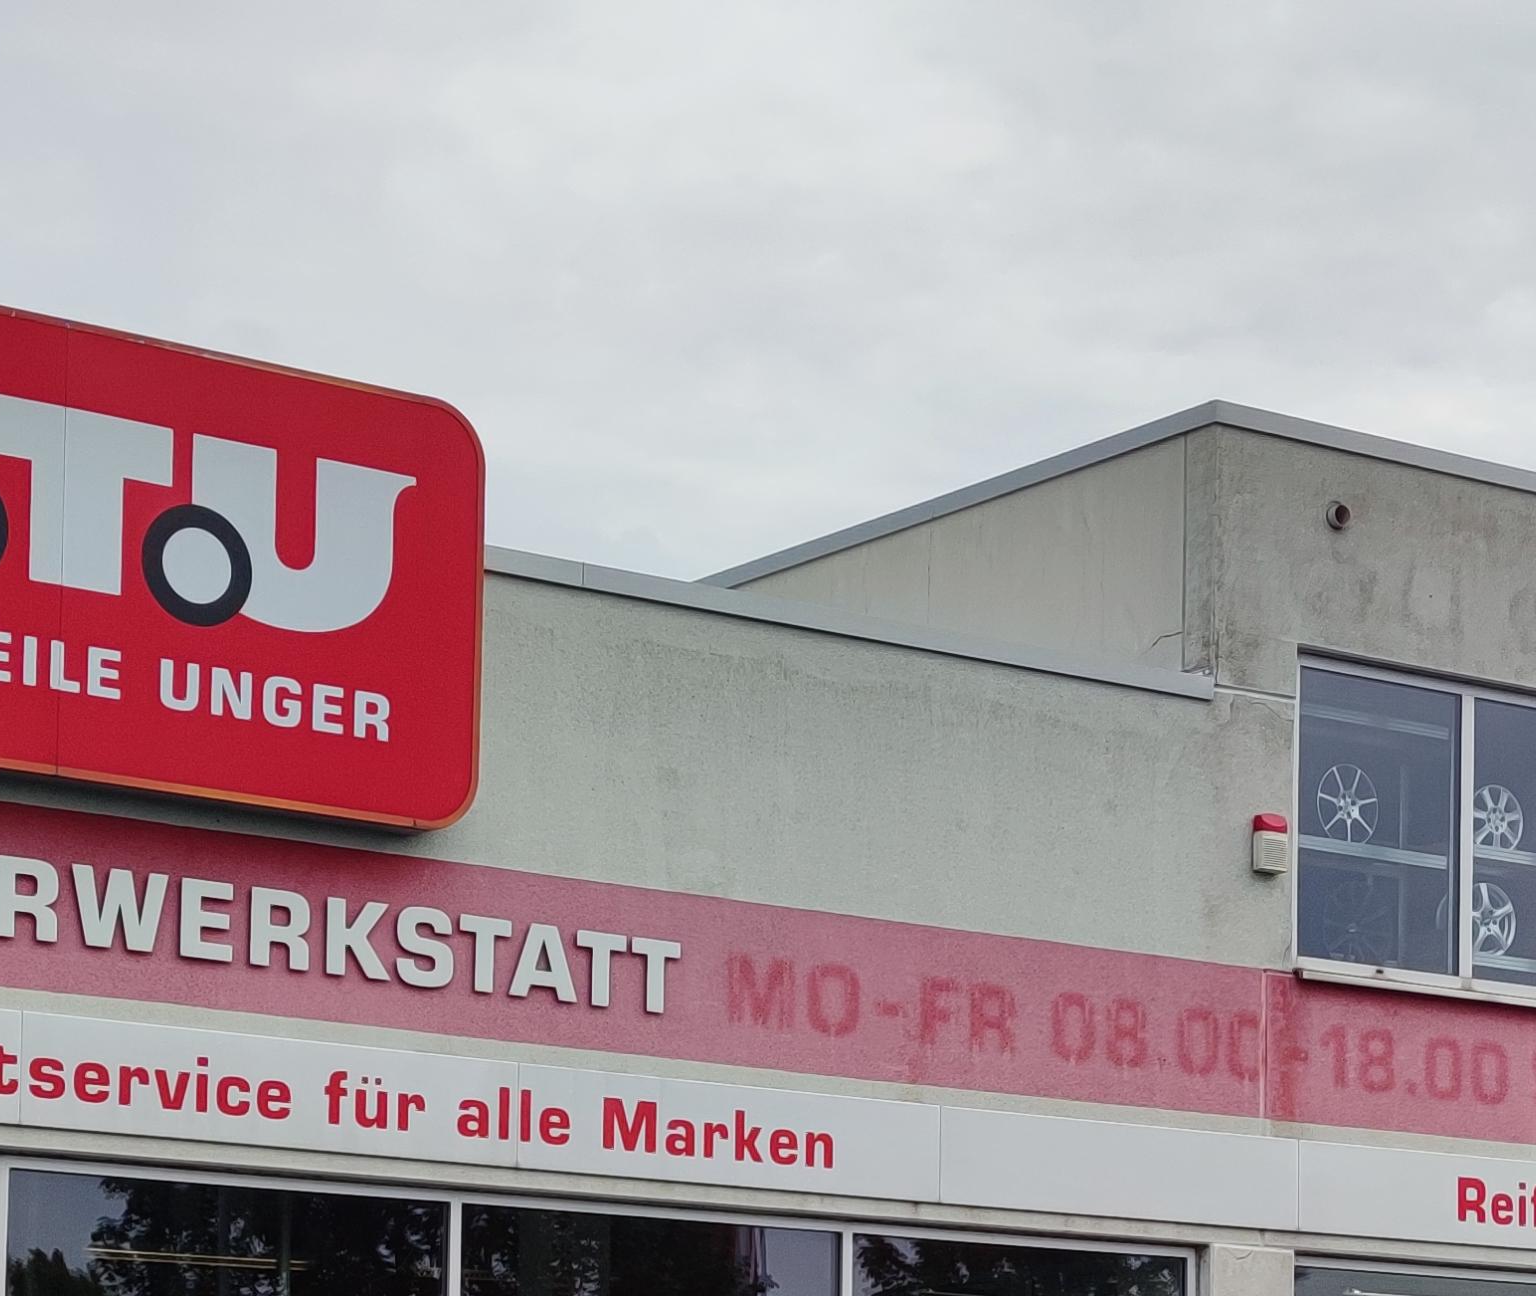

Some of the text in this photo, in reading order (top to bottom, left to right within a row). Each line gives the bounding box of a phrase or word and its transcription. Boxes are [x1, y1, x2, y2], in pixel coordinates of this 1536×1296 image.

[158, 658, 391, 742] UNGER
[325, 1071, 426, 1132] für
[456, 1087, 571, 1146] alle
[602, 1097, 835, 1169] Marken
